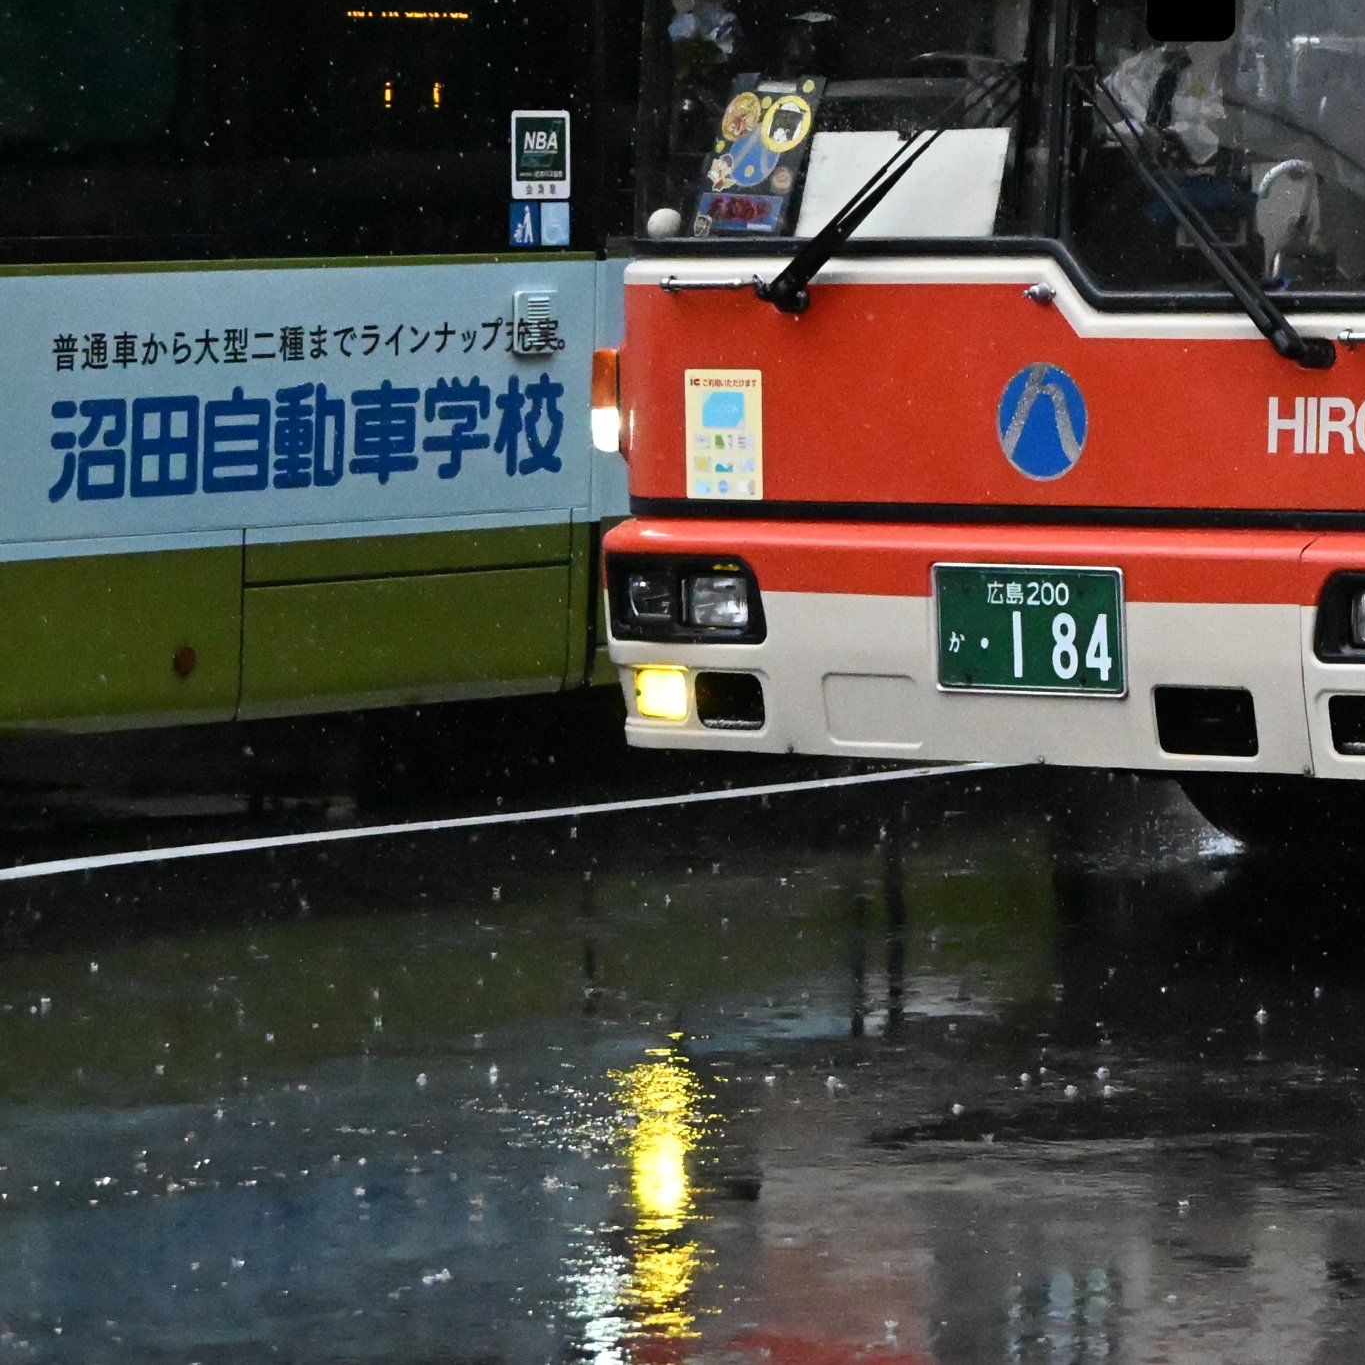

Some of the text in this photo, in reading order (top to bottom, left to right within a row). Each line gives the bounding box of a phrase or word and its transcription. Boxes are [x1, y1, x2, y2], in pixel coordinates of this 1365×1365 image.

[523, 131, 559, 151] NBA
[48, 372, 566, 504] 沼田自動車学校
